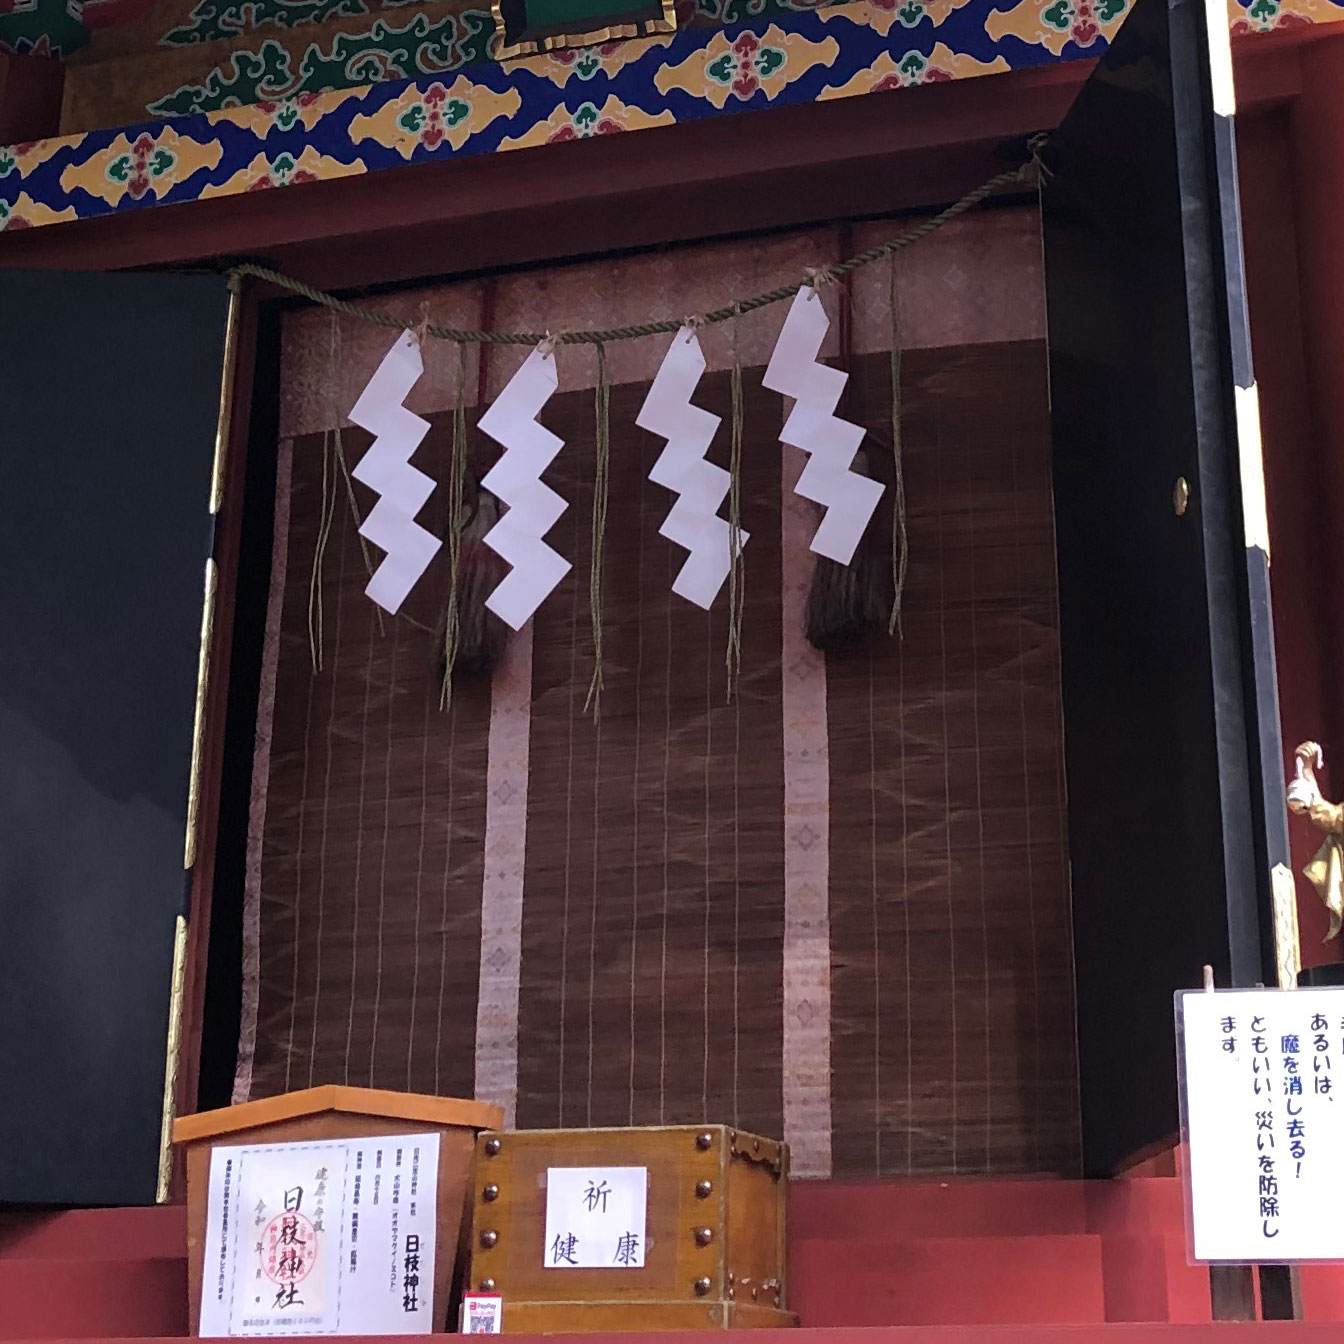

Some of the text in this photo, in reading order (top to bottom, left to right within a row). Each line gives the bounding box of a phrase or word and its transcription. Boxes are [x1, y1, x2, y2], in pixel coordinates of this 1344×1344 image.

[1220, 1016, 1239, 1062] ます。
[1311, 1013, 1333, 1102] あるいは、
[1251, 1015, 1280, 1238] ともいい、災いを防除し
[1281, 1034, 1306, 1179] 魔を消し去る！
[582, 1180, 612, 1213] 祈
[272, 1186, 306, 1310] 日枝神社
[403, 1234, 420, 1312] 日枝神社
